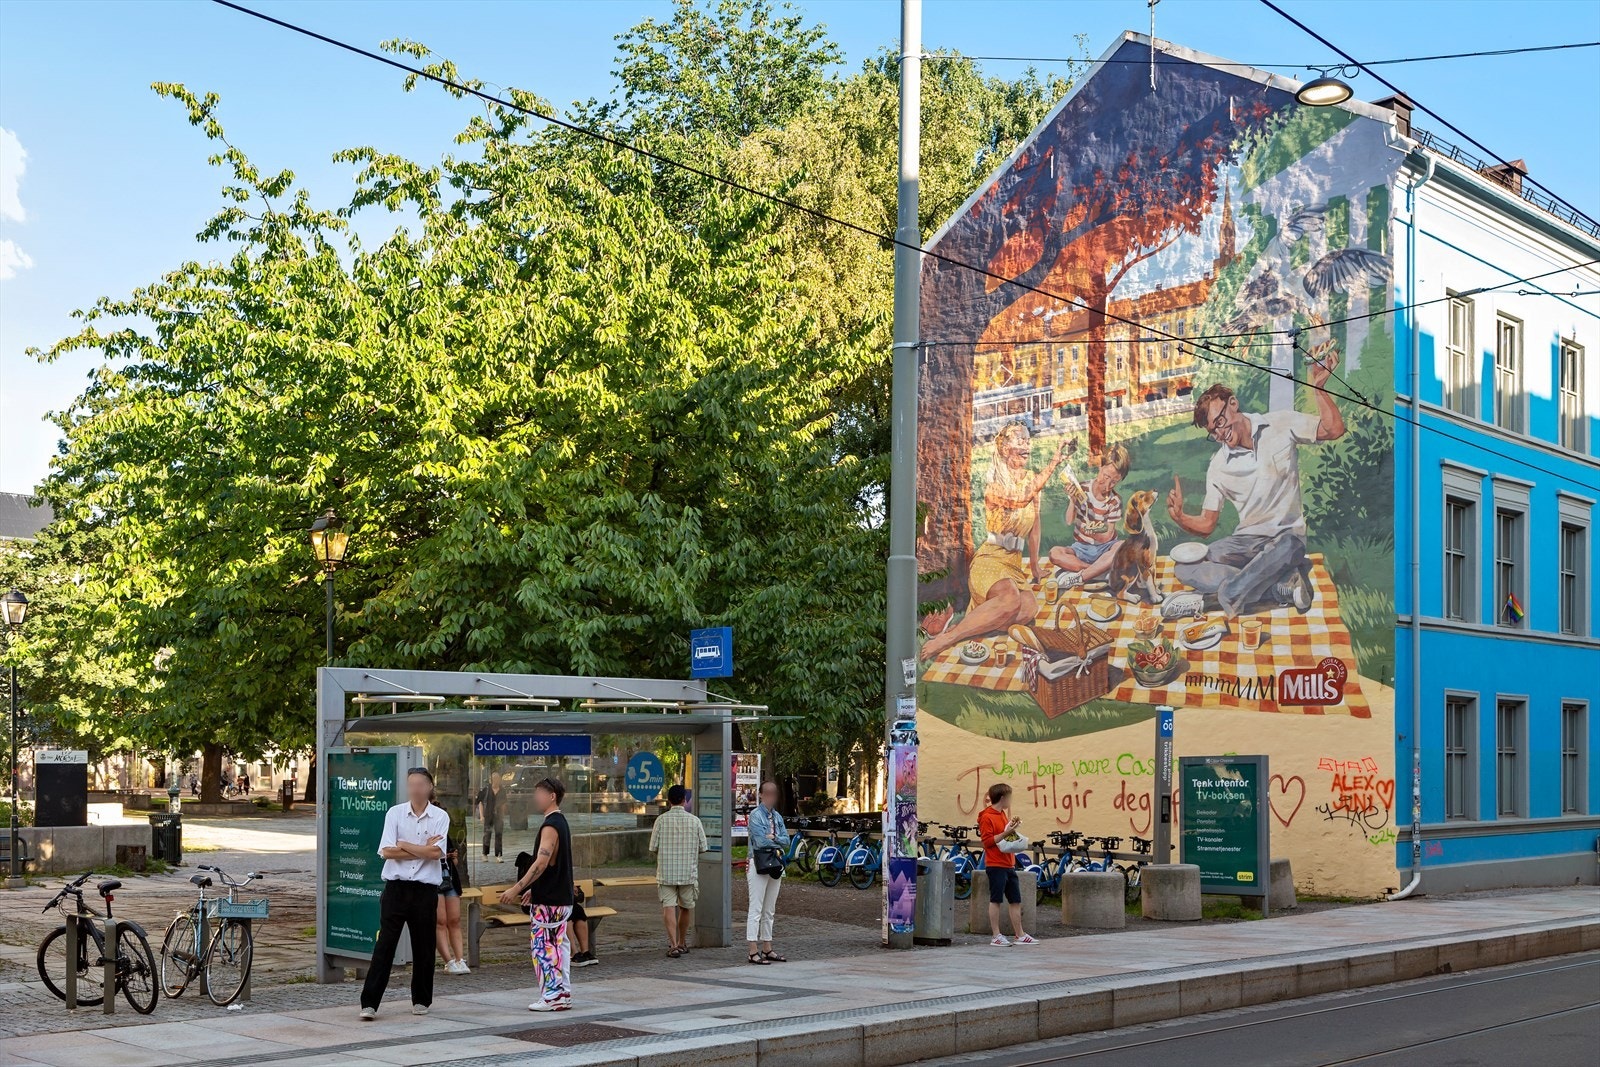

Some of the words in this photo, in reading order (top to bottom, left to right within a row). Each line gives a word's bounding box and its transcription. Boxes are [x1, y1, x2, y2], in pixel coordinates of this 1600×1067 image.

[1283, 673, 1339, 700] Mills
[476, 737, 519, 751] Schous
[521, 737, 550, 754] plass
[638, 761, 652, 784] 5
[650, 774, 663, 783] min
[358, 776, 392, 791] utenfor
[1192, 778, 1214, 788] Tenk
[1214, 778, 1249, 788] utenfor
[1331, 773, 1375, 793] ALEX
[340, 796, 388, 812] TV-boksen
[1027, 771, 1093, 826] tilgir
[1113, 779, 1152, 835] deg
[1196, 791, 1245, 801] TV-boksen
[339, 870, 365, 881] TV-kanaler
